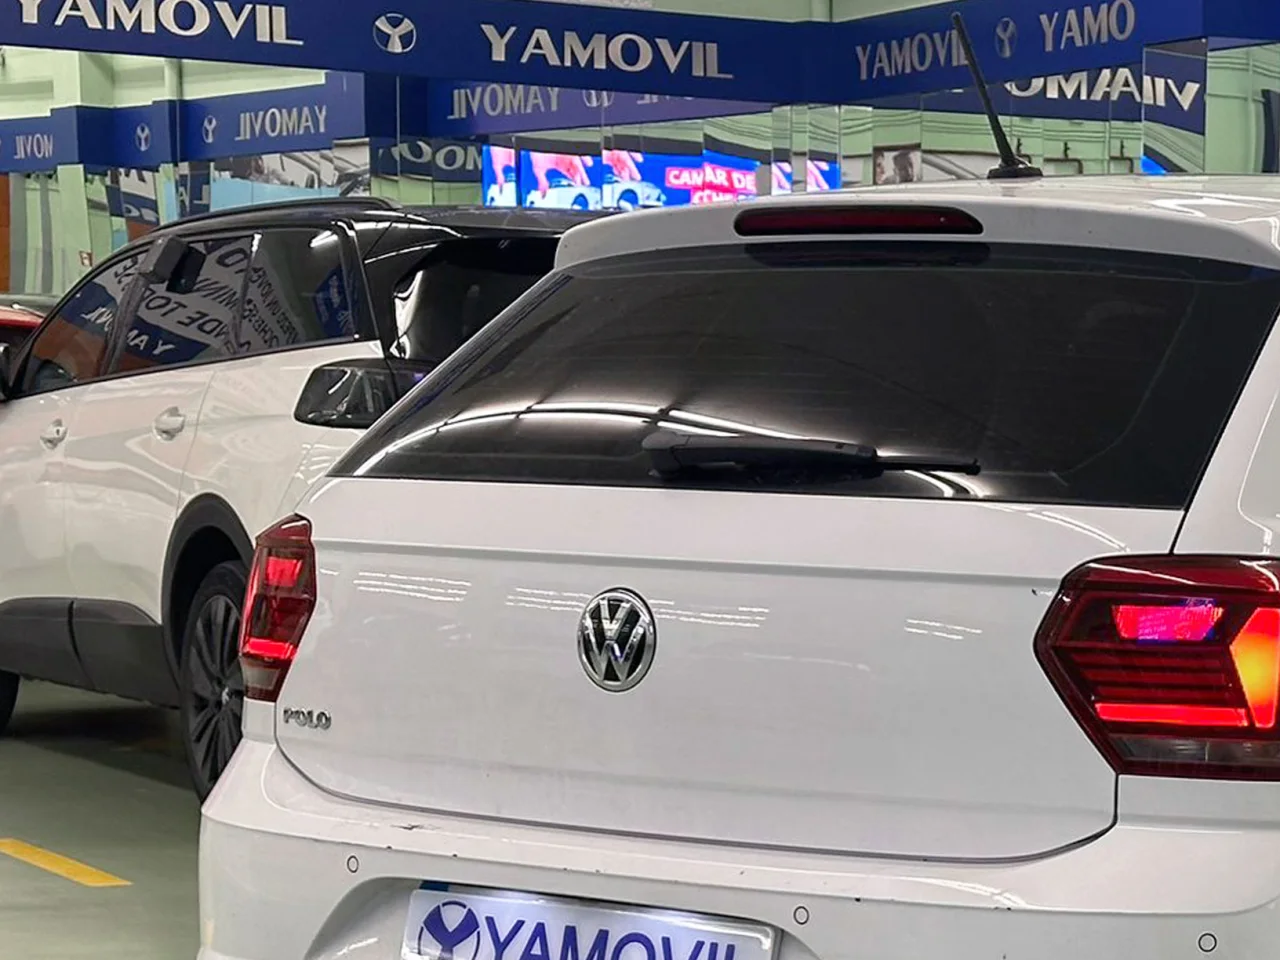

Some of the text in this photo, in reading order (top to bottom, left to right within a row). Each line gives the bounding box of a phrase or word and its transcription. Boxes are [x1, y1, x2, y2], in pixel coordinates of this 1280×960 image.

[17, 0, 304, 45] YAMOVIL
[1039, 0, 1136, 52] YAMO
[480, 23, 734, 79] YAMOVIL
[282, 706, 332, 731] POLO
